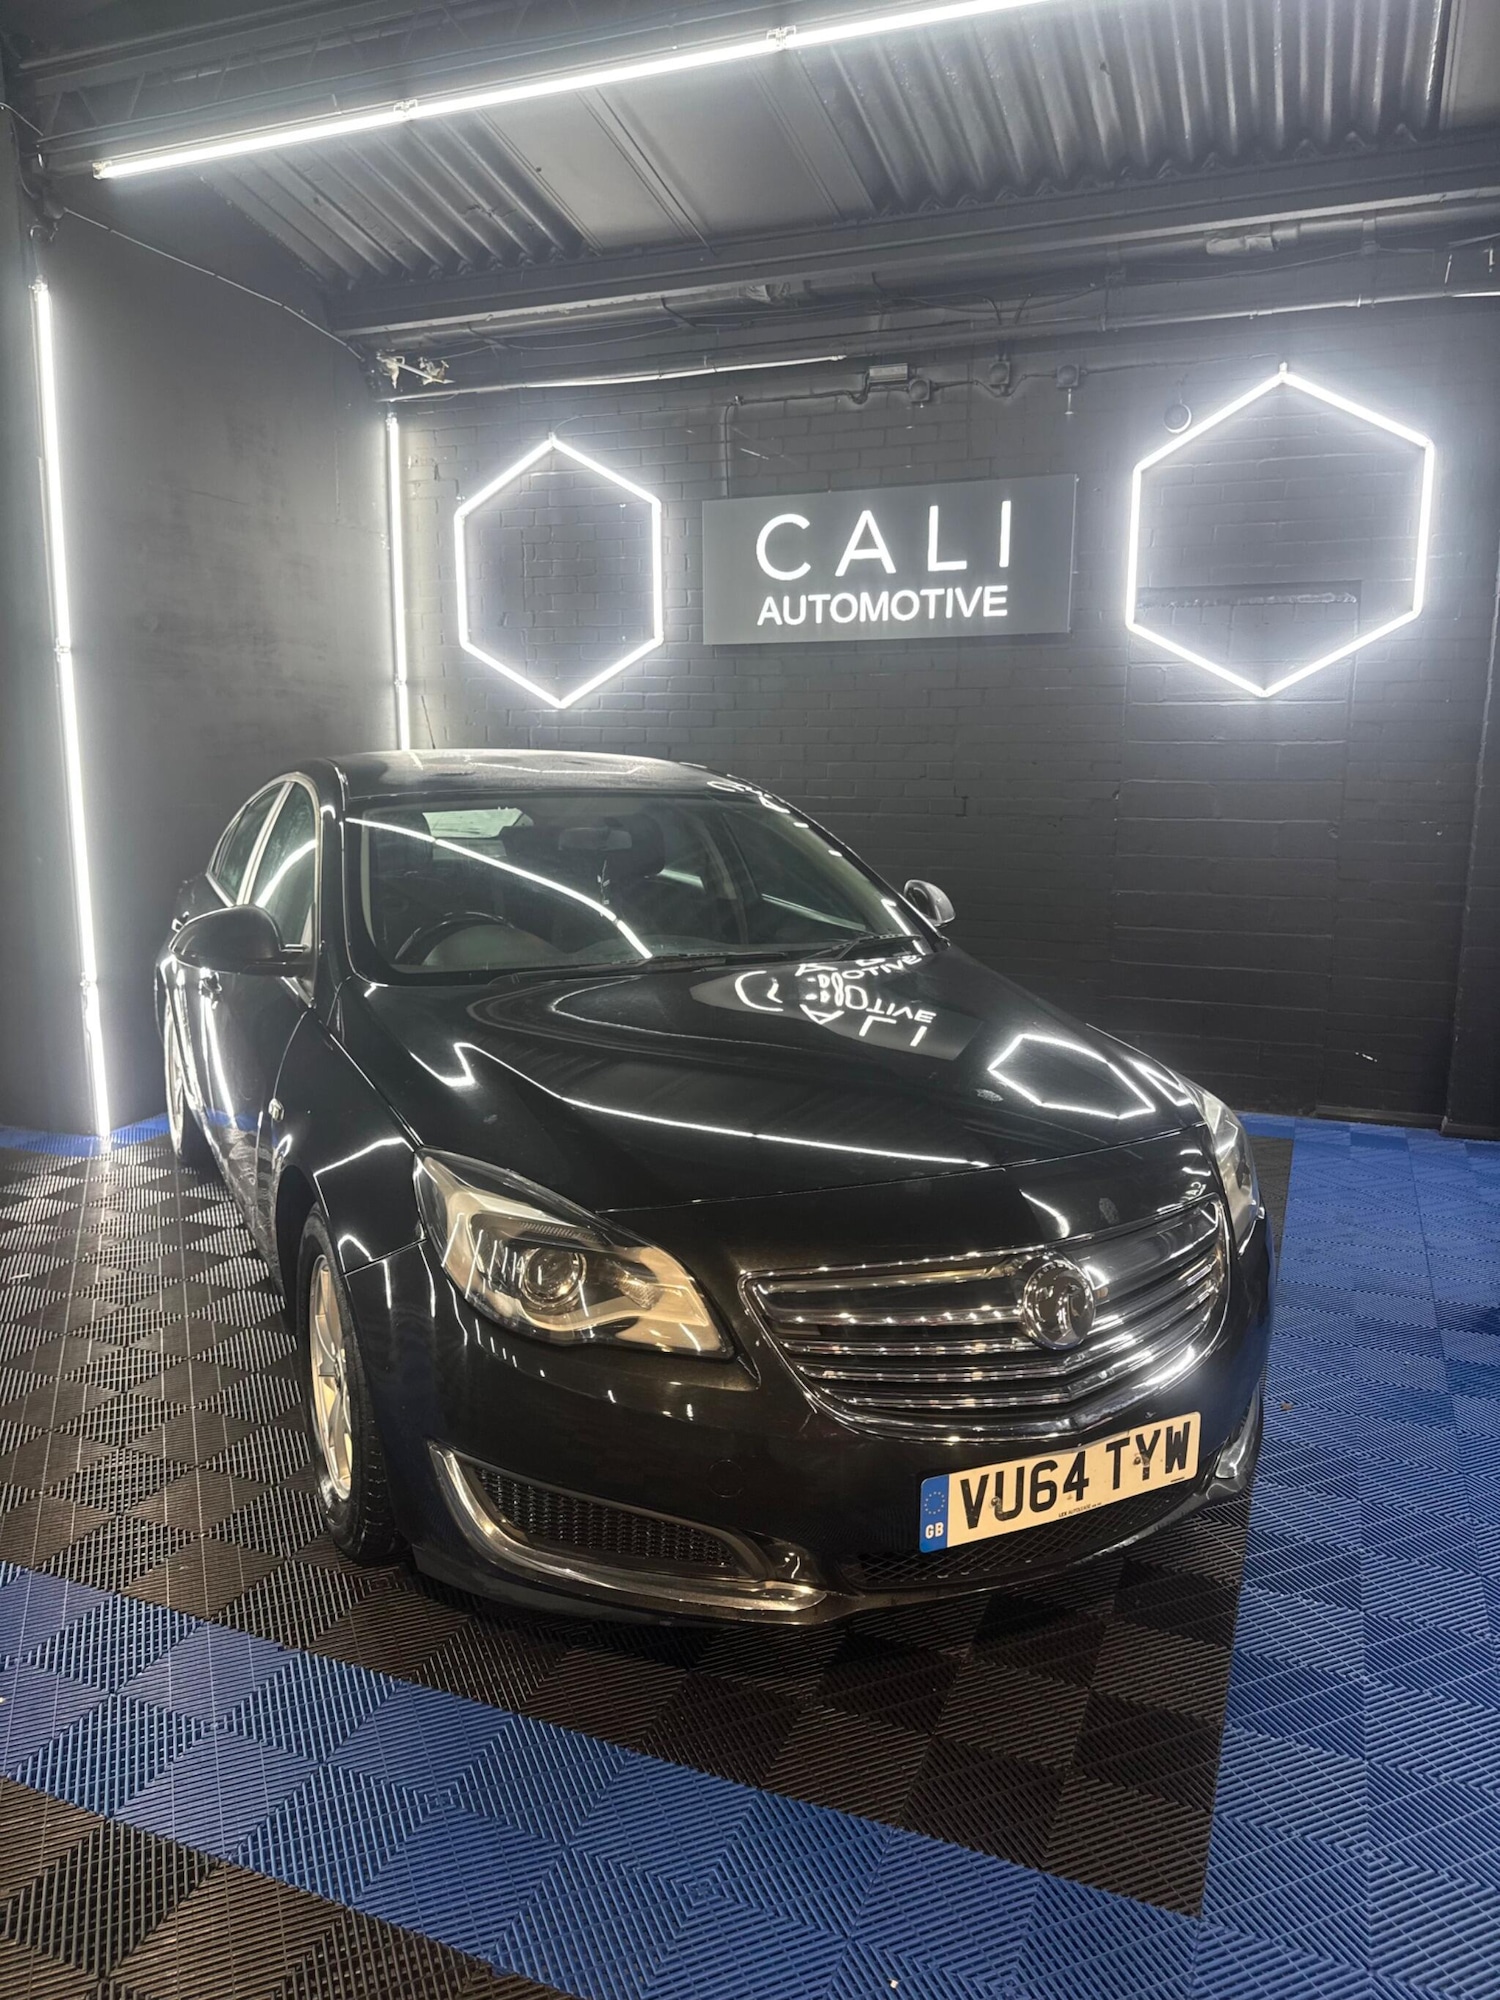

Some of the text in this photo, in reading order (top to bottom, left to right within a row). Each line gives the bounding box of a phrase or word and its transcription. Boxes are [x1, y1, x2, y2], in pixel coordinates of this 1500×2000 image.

[756, 500, 1012, 581] CALI
[756, 585, 1009, 627] AUTOMOTIVE
[960, 1421, 1191, 1530] VU64 TYW
[925, 1521, 944, 1540] GB
